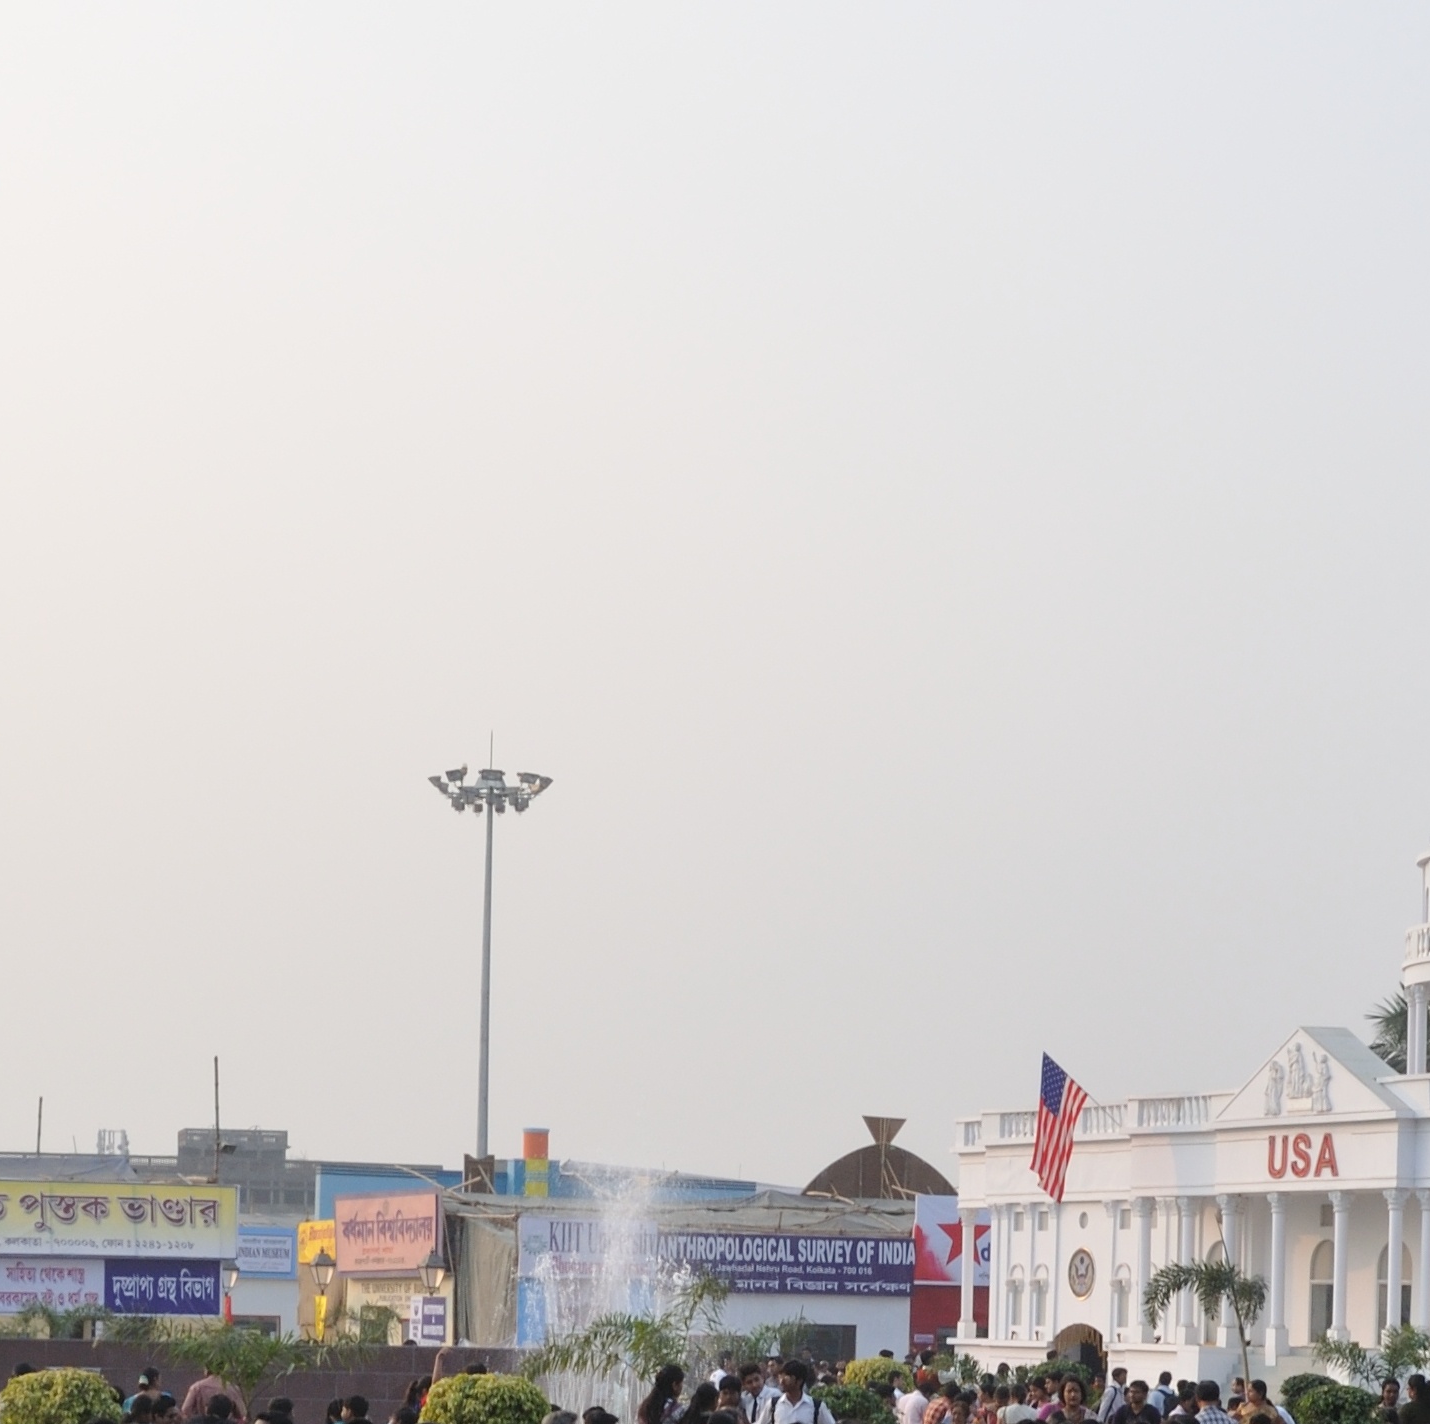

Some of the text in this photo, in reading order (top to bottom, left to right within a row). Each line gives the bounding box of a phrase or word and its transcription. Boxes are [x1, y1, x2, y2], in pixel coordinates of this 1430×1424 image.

[1268, 1132, 1339, 1179] USA
[19, 1191, 109, 1232] পুস্তক
[117, 1194, 220, 1226] ভাণ্ডার
[549, 1221, 584, 1252] KIIT
[657, 1236, 915, 1265] ANTHROPOLOGICAL SURVEY OF INDIA
[262, 1248, 290, 1259] MUSEUM
[180, 1268, 215, 1300] বিভাগ
